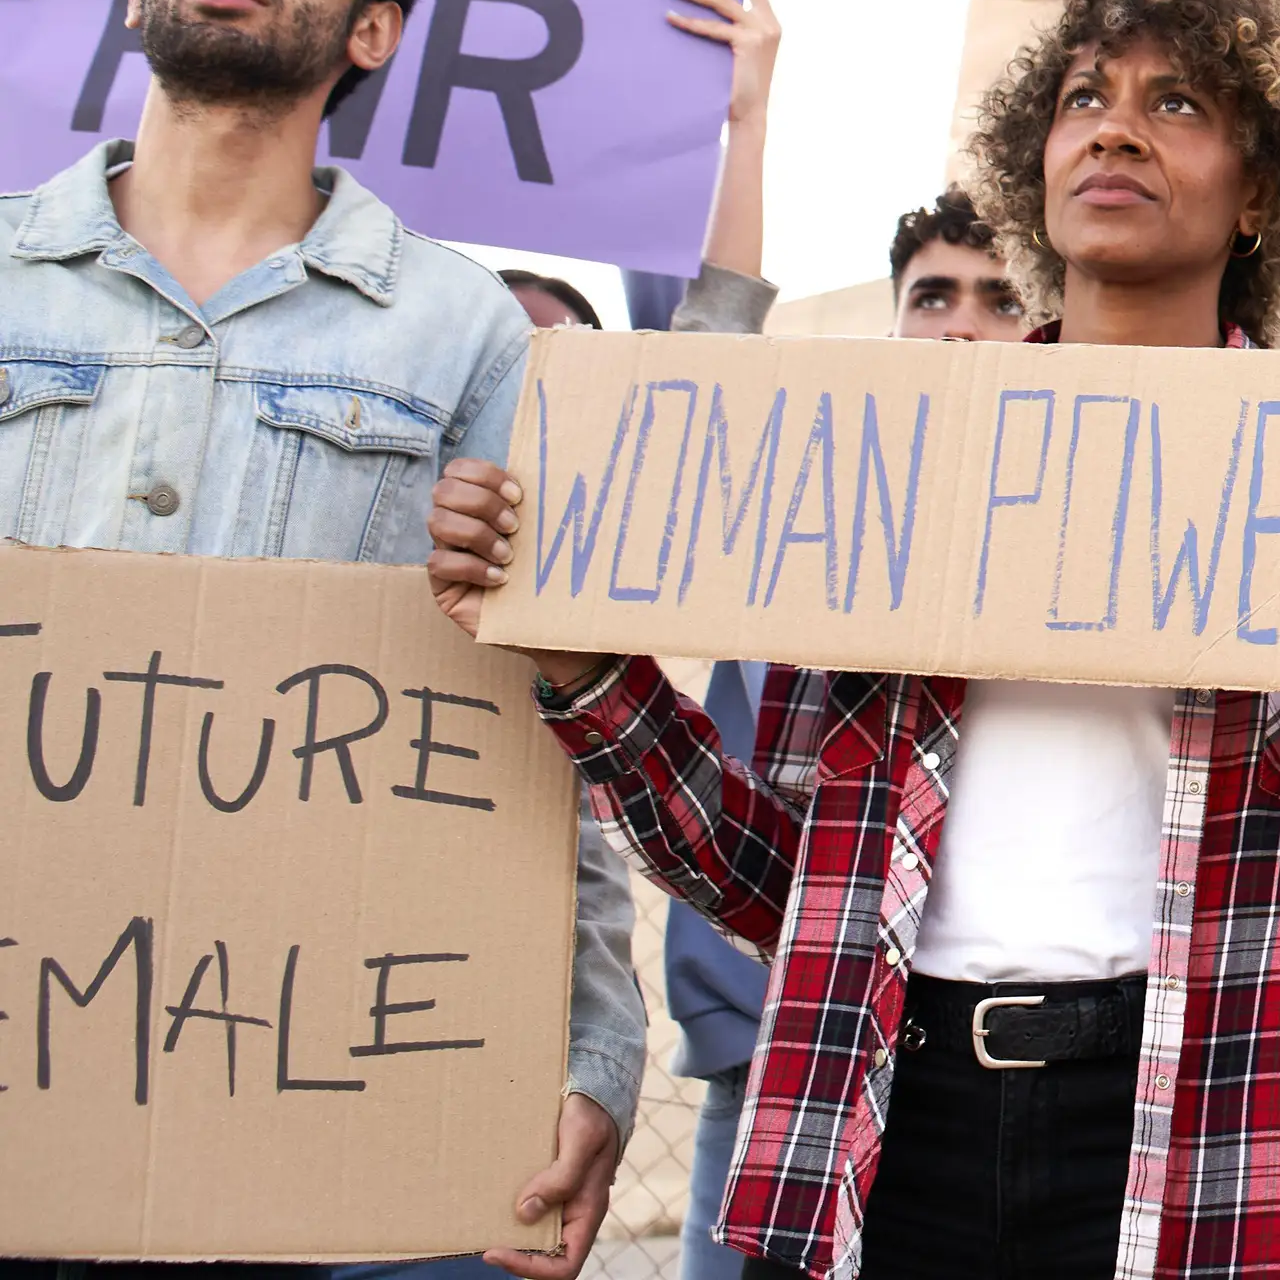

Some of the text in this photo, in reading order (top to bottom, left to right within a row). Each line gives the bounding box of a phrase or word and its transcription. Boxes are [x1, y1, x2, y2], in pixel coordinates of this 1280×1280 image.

[536, 378, 929, 613] WOMAN
[0, 622, 500, 813] UTURE
[0, 916, 485, 1105] MALE
